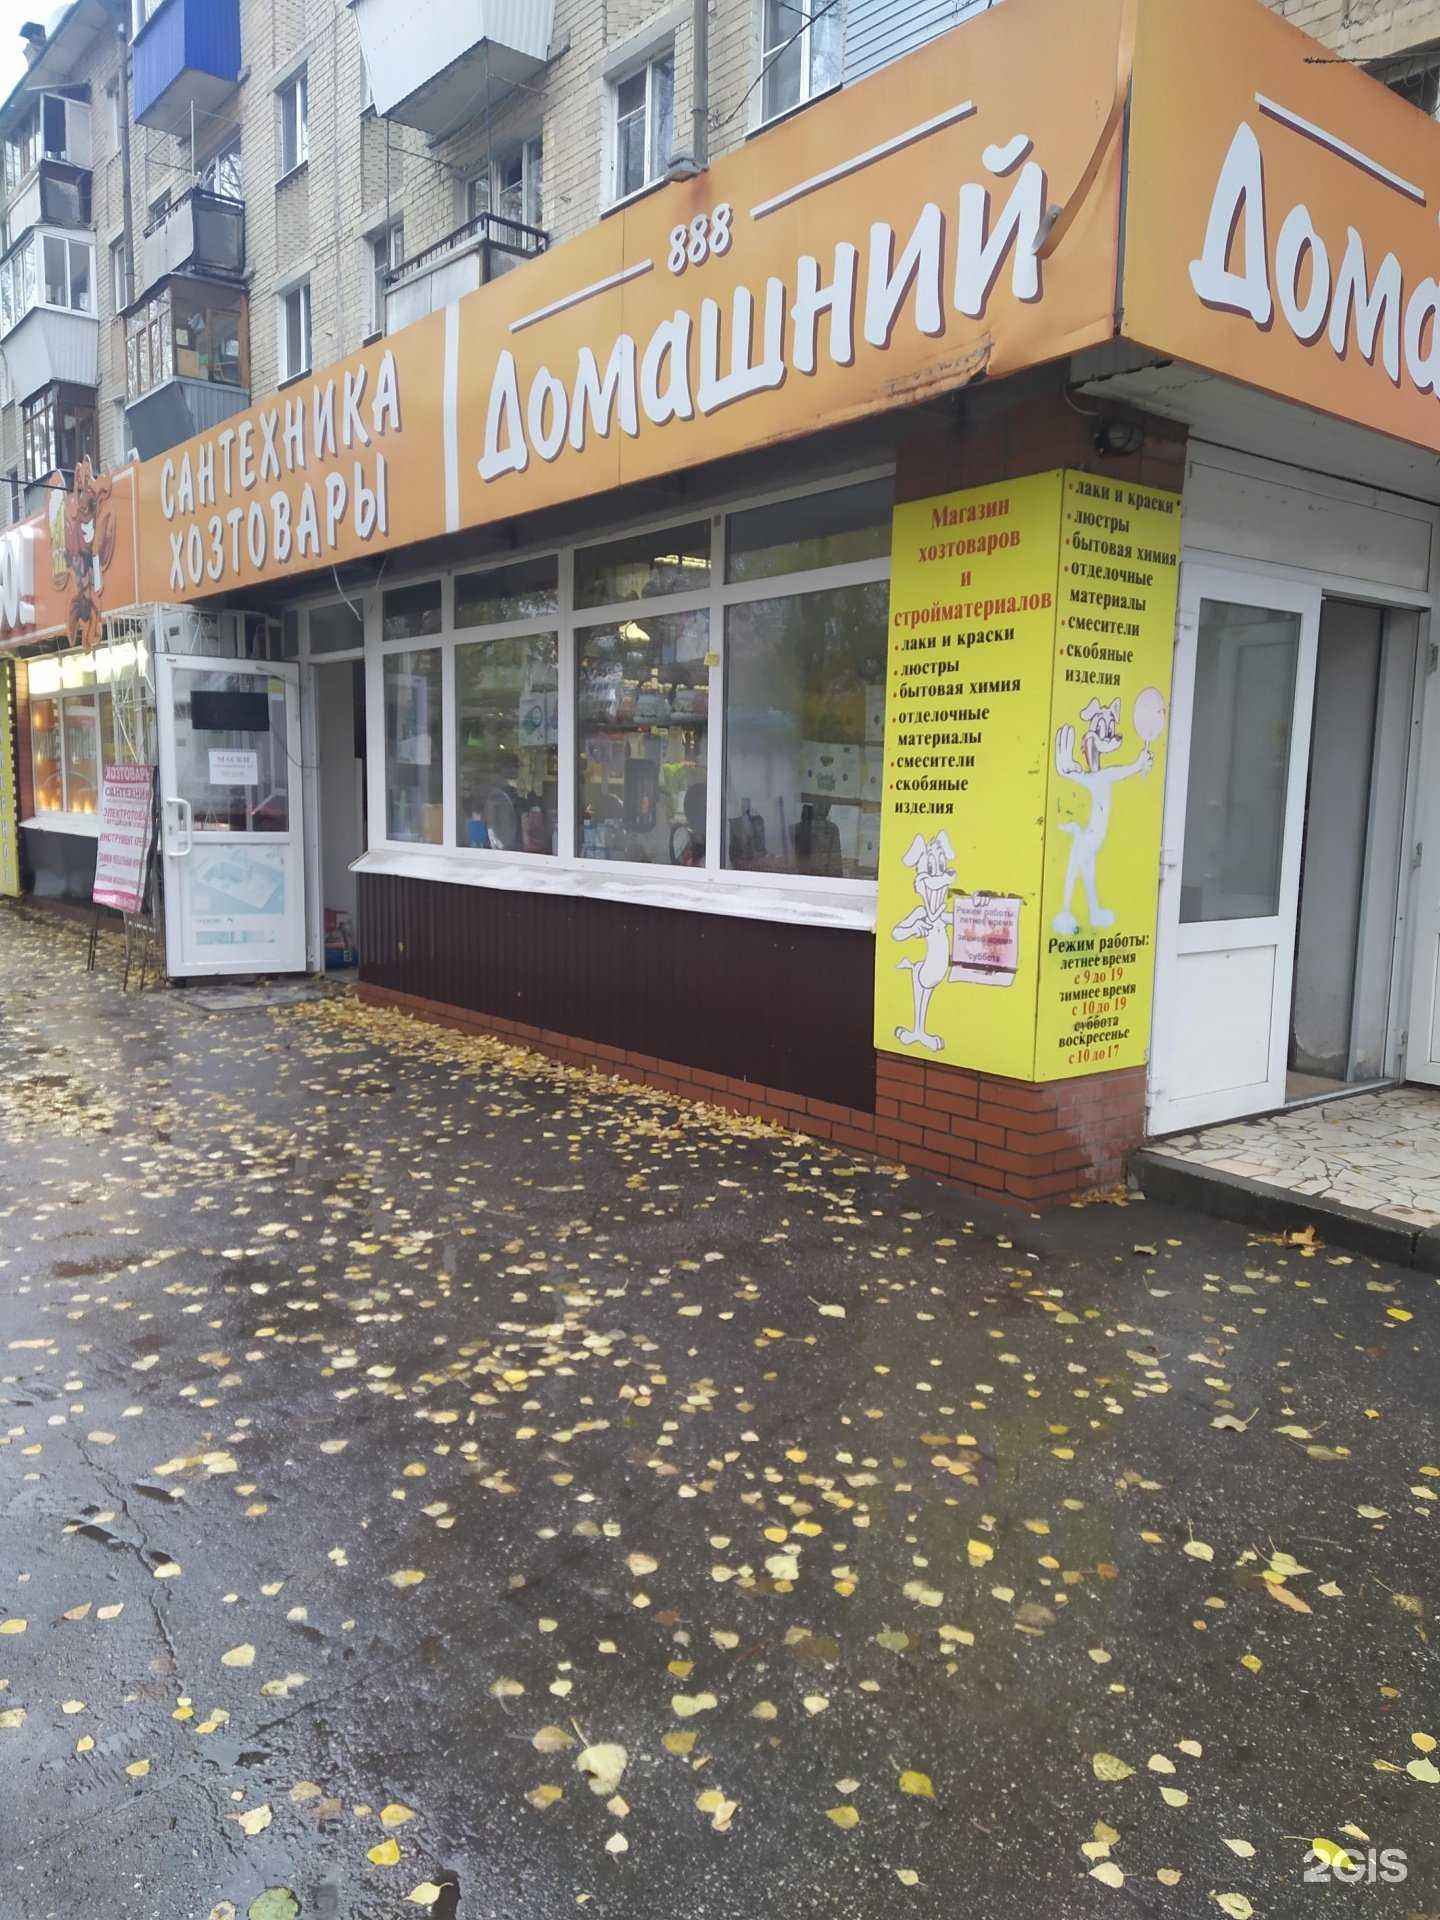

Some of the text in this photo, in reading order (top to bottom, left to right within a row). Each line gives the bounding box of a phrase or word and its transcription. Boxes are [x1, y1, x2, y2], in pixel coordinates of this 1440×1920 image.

[668, 203, 733, 273] 888
[160, 349, 400, 520] САНТЕХНИКА
[1075, 480, 1174, 514] лаки и краски
[169, 452, 388, 591] ХОЗТОВАРЫ
[931, 498, 1010, 529] Магазин
[1074, 510, 1130, 533] люстры
[918, 530, 1021, 563] хозтоваров
[1072, 532, 1177, 566] бытовая химия
[960, 571, 972, 587] и
[1071, 561, 1154, 586] отделочные
[1070, 588, 1146, 611] материалы
[894, 592, 1052, 629] стройматериалов
[1068, 615, 1140, 636] смесители
[901, 628, 1015, 652] лаки и краски
[1066, 643, 1134, 663] скобяные
[900, 660, 960, 676] люстры
[1065, 668, 1121, 686] изделия
[899, 679, 1021, 699] бытовая химия
[898, 707, 990, 724] отделочные
[898, 731, 982, 748] материалы
[896, 755, 975, 768] смесители
[895, 775, 969, 791] скобяные
[895, 801, 955, 815] изделия
[1048, 932, 1149, 954] Режим работы:
[1060, 953, 1136, 970] летнее время
[1083, 969, 1091, 984] 9
[1111, 967, 1123, 981] 19
[1059, 984, 1136, 1002] зимнее время
[1082, 1001, 1095, 1015] 10
[1114, 997, 1127, 1011] 19
[1074, 1016, 1119, 1034] суббота
[1058, 1028, 1130, 1048] воскресенье
